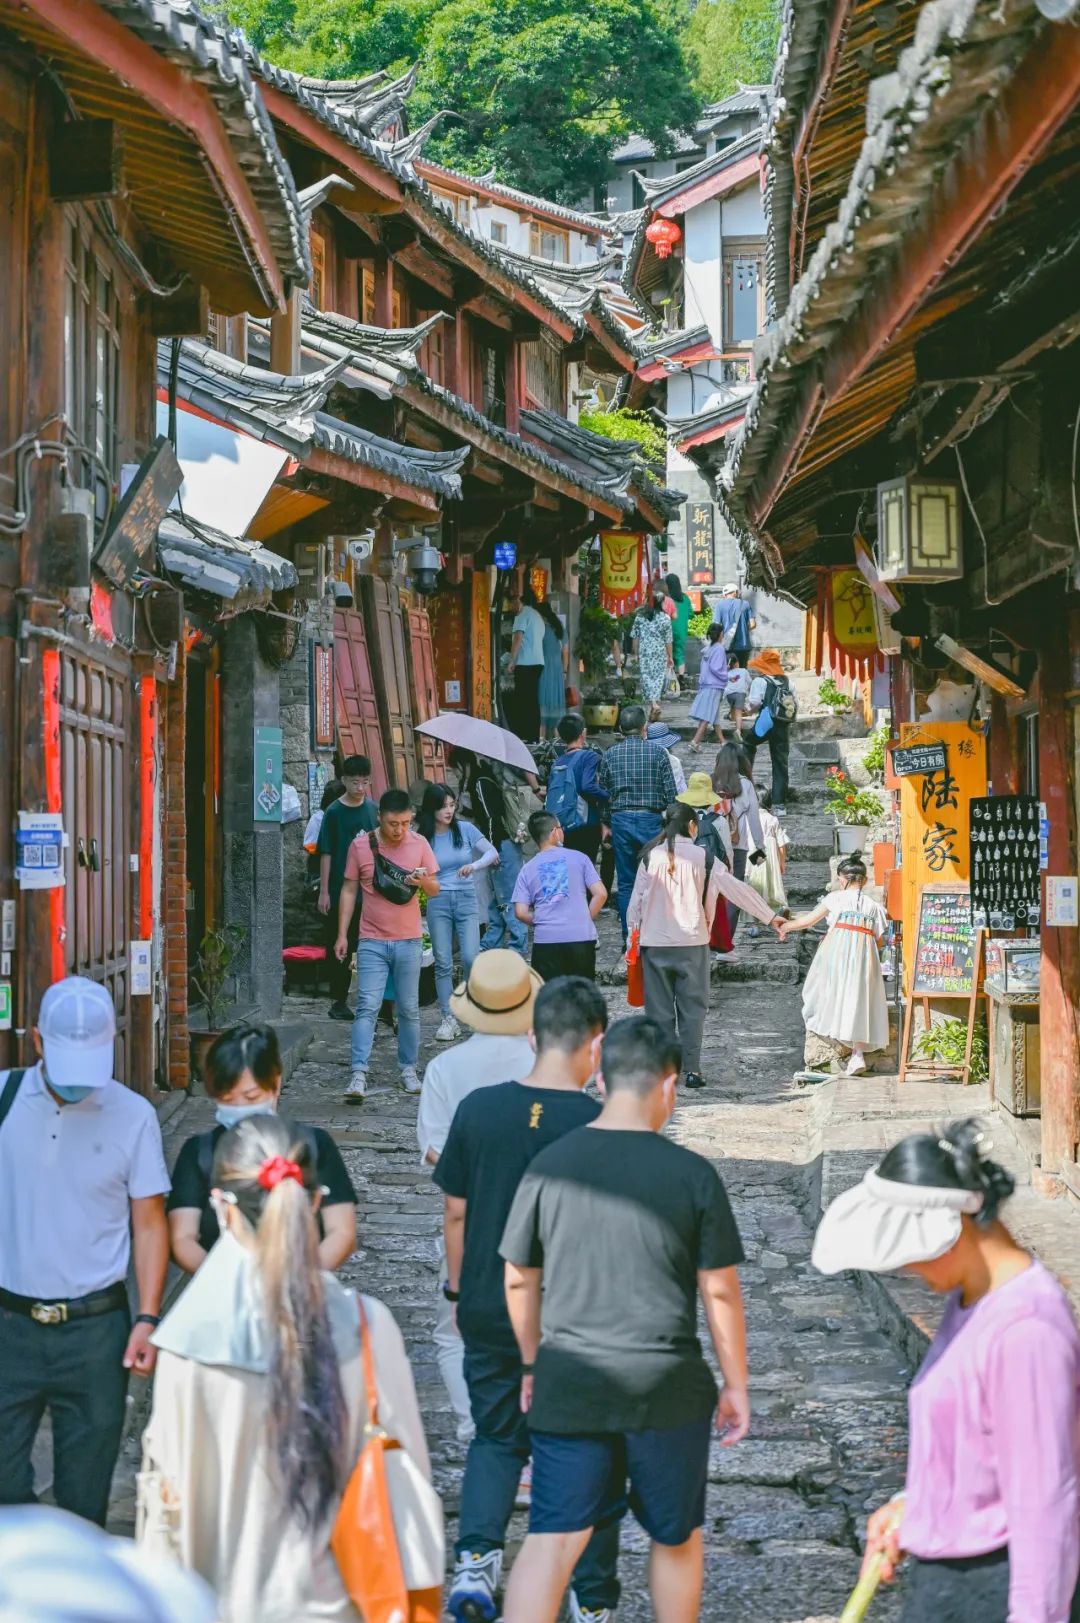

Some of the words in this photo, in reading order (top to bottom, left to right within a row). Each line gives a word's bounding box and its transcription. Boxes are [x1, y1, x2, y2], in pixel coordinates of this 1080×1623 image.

[692, 508, 710, 568] 新龍門
[911, 754, 944, 769] 今日有房
